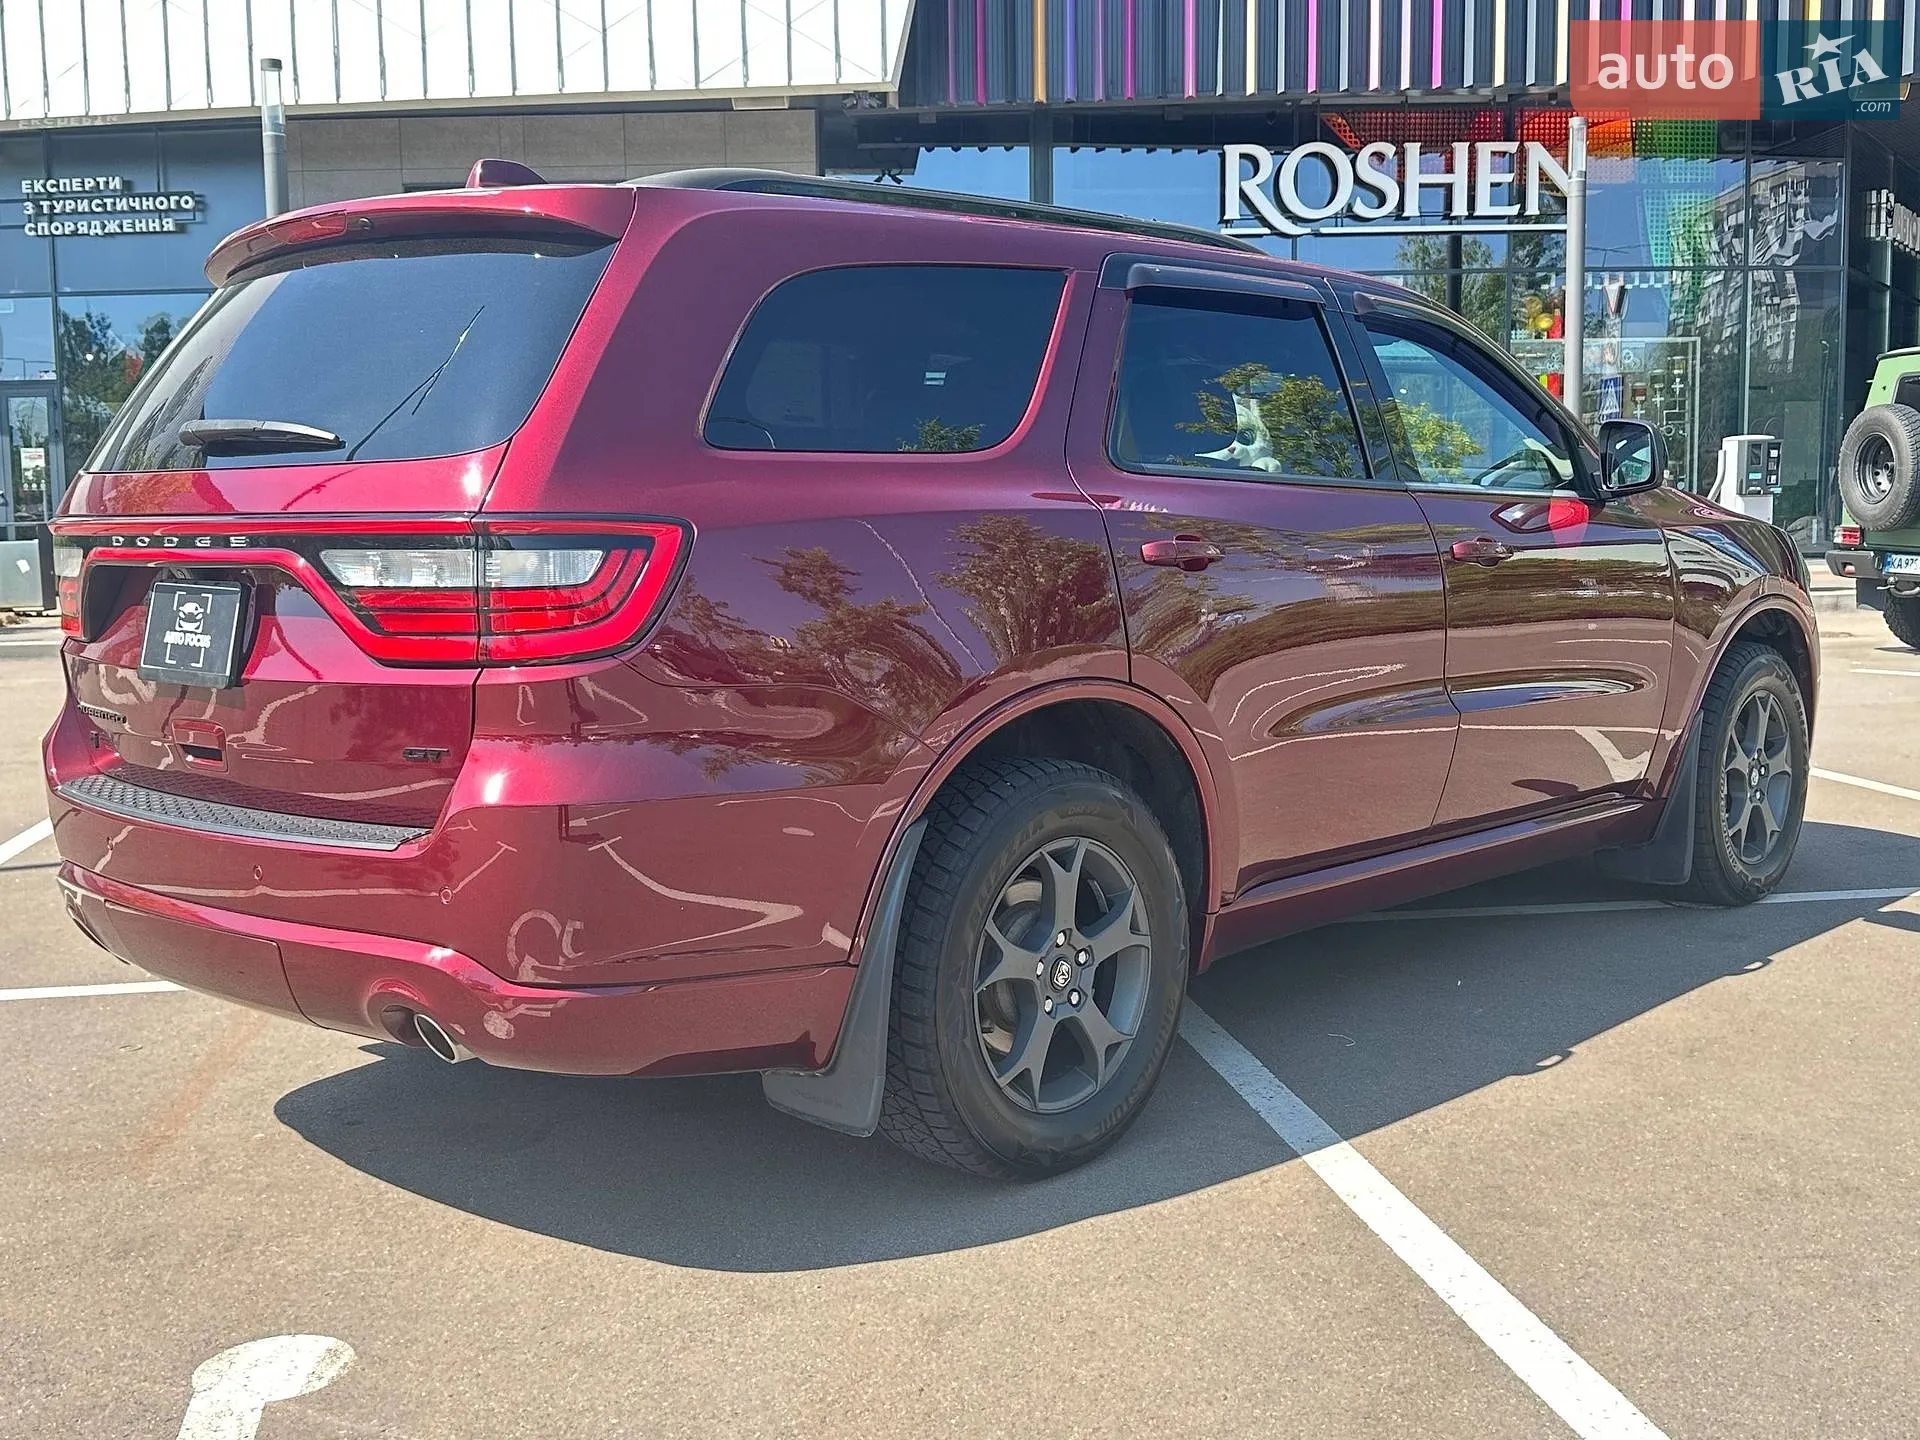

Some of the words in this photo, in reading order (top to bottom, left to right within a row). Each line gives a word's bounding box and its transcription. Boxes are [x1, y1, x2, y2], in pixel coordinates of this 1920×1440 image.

[21, 176, 123, 194] ЕКСПЕРТИ
[1222, 141, 1569, 235] ROSHEN
[39, 195, 195, 214] ТУРИСТИЧНОГО
[24, 217, 176, 236] СПОРЯДЖЕННЯ
[112, 536, 249, 547] DODGE
[163, 630, 185, 646] AUTO
[184, 632, 212, 649] FOCUS
